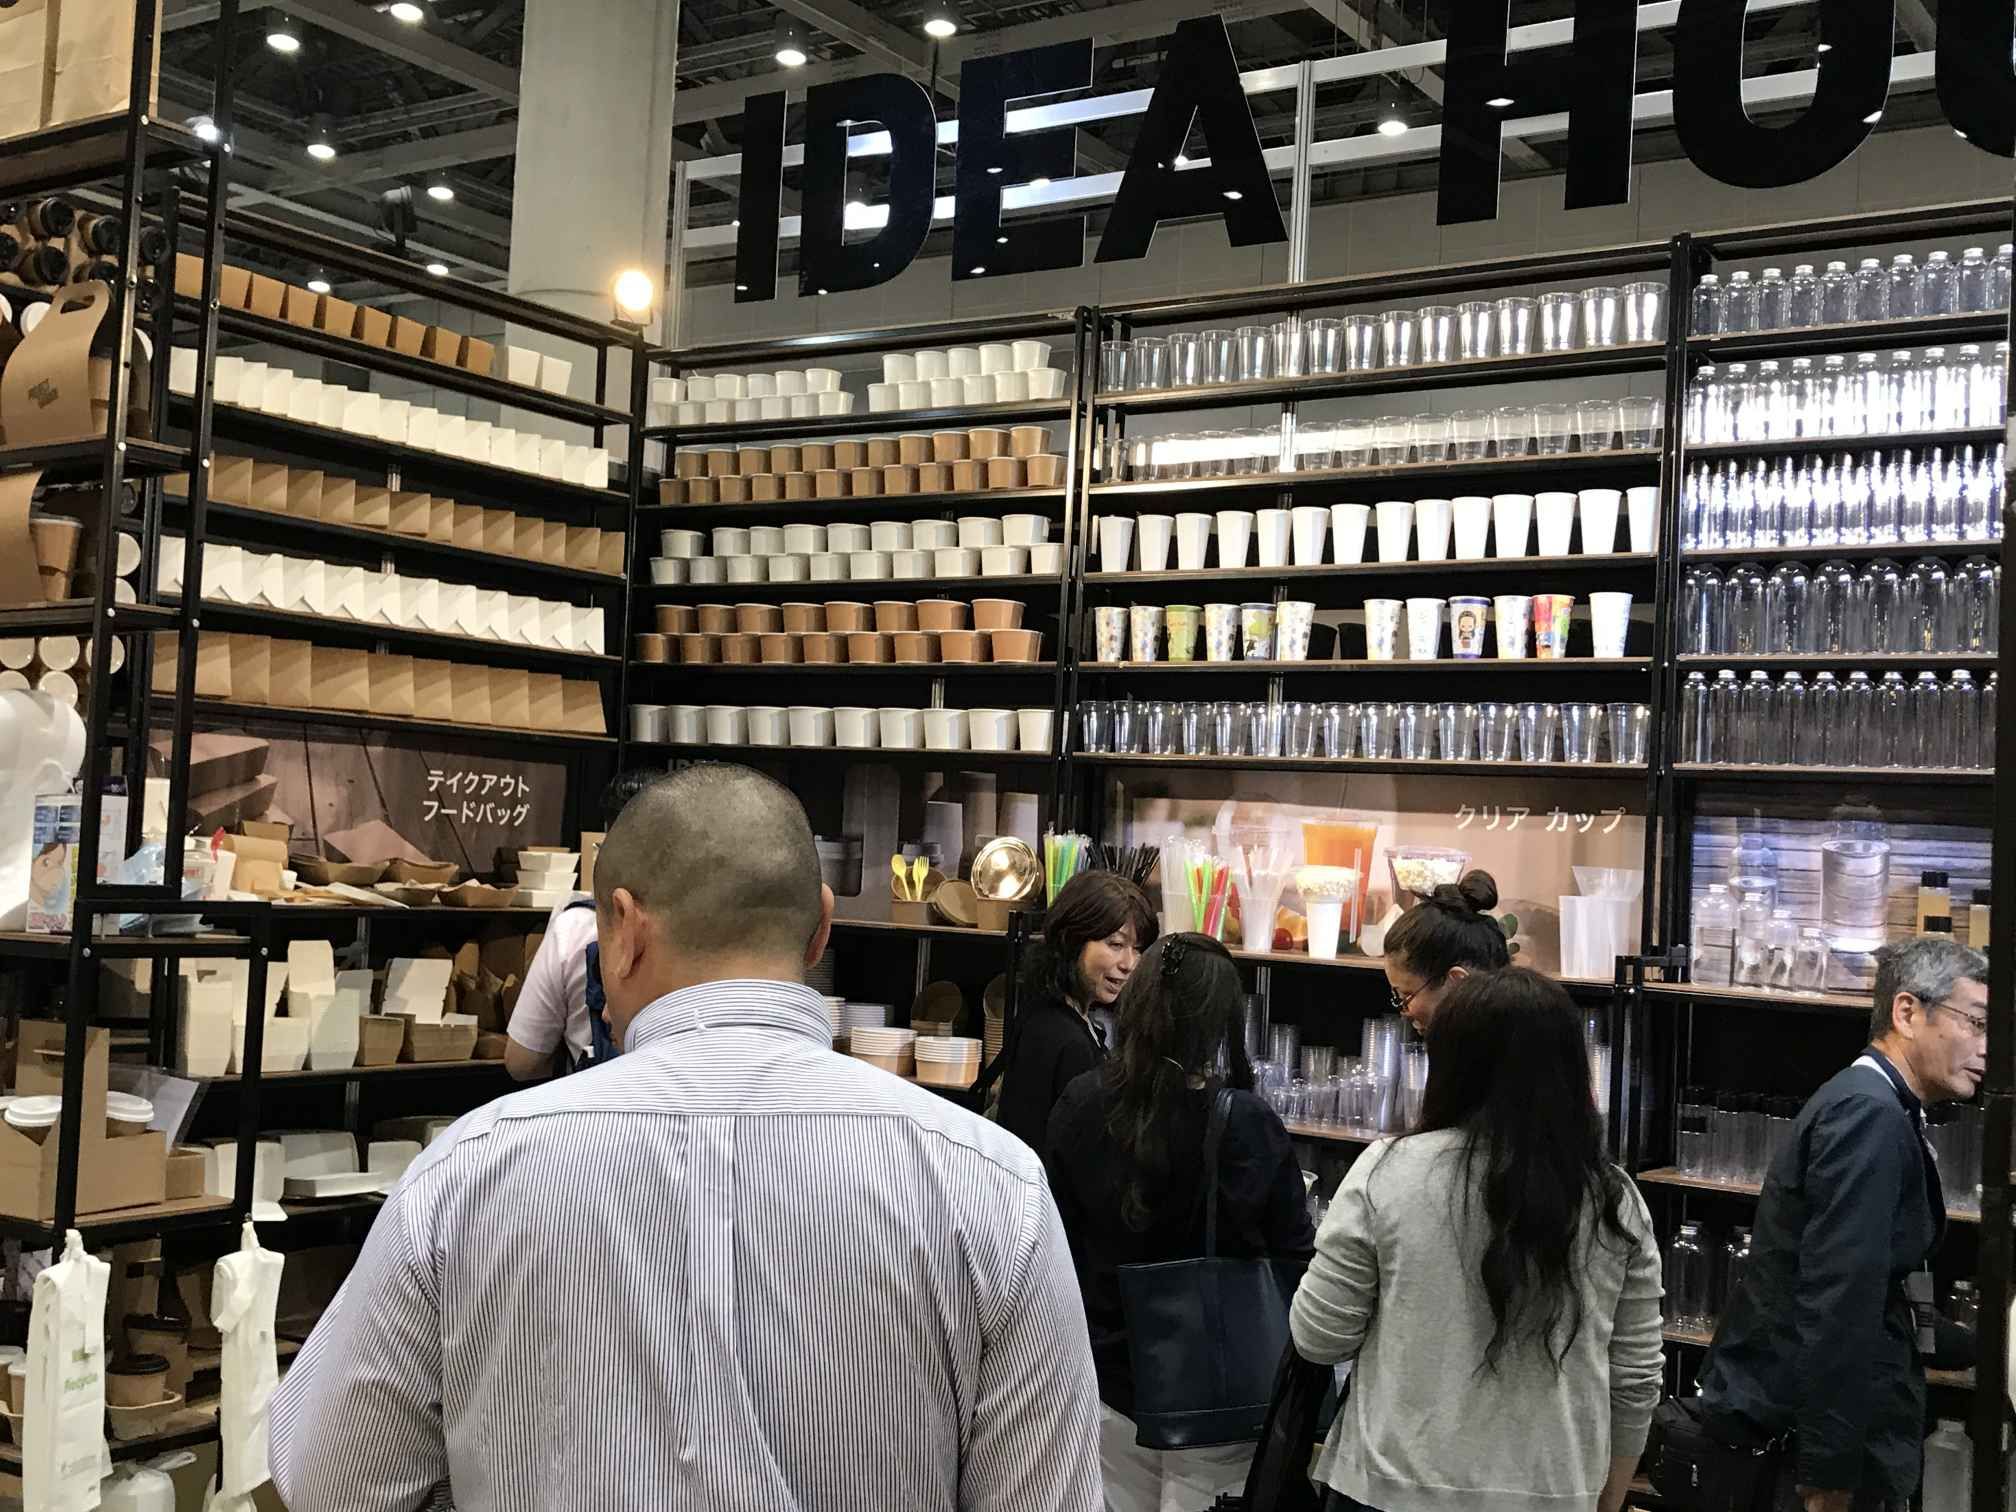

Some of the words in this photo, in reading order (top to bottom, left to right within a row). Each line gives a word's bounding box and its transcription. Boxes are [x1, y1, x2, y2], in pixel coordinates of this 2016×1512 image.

[734, 14, 1288, 303] IDEA
[426, 769, 530, 798] テイクアウト
[422, 800, 530, 827] フードバッグ
[1454, 804, 1530, 831] クリア
[1545, 805, 1627, 834] カップ
